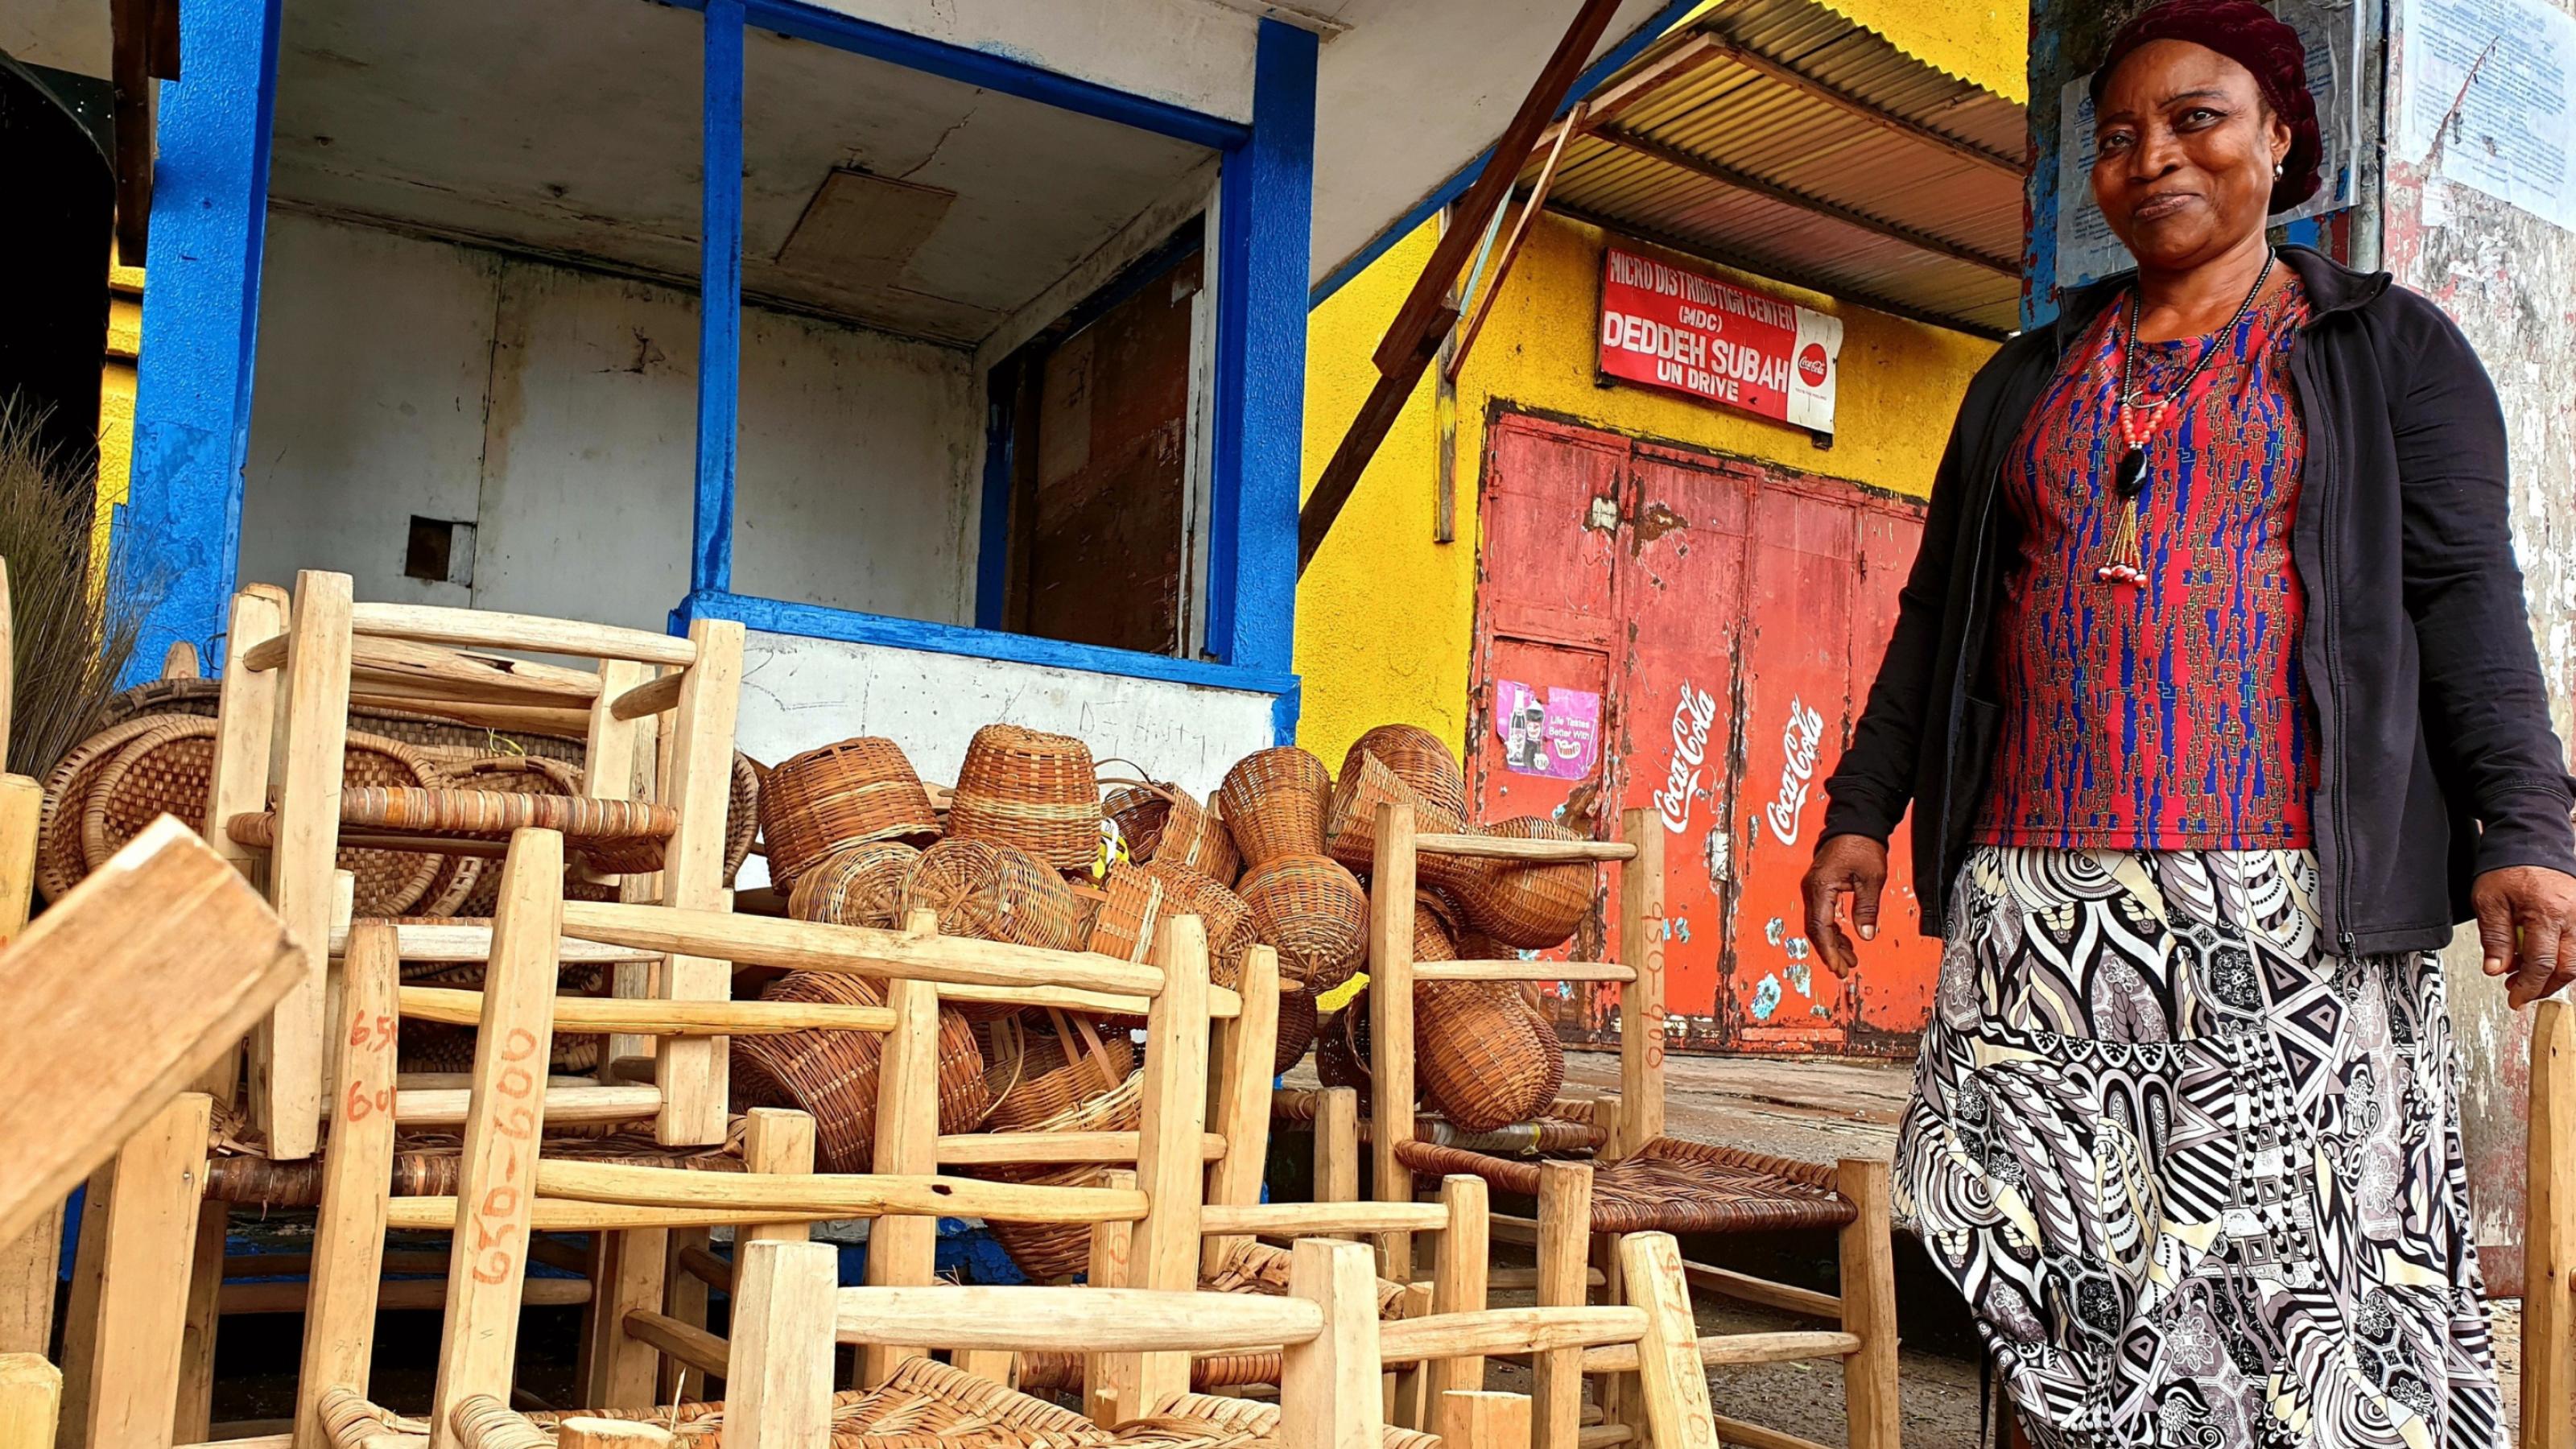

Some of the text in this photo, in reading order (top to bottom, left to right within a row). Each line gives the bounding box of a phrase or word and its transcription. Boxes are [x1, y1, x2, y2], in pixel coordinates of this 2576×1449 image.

[1610, 250, 1795, 332] MICRO DISTRIBUTION CENTER
[1678, 305, 1723, 333] (MDC)
[1603, 310, 1789, 393] DEDDEH SUBAH
[1657, 359, 1739, 402] UN DRIVE
